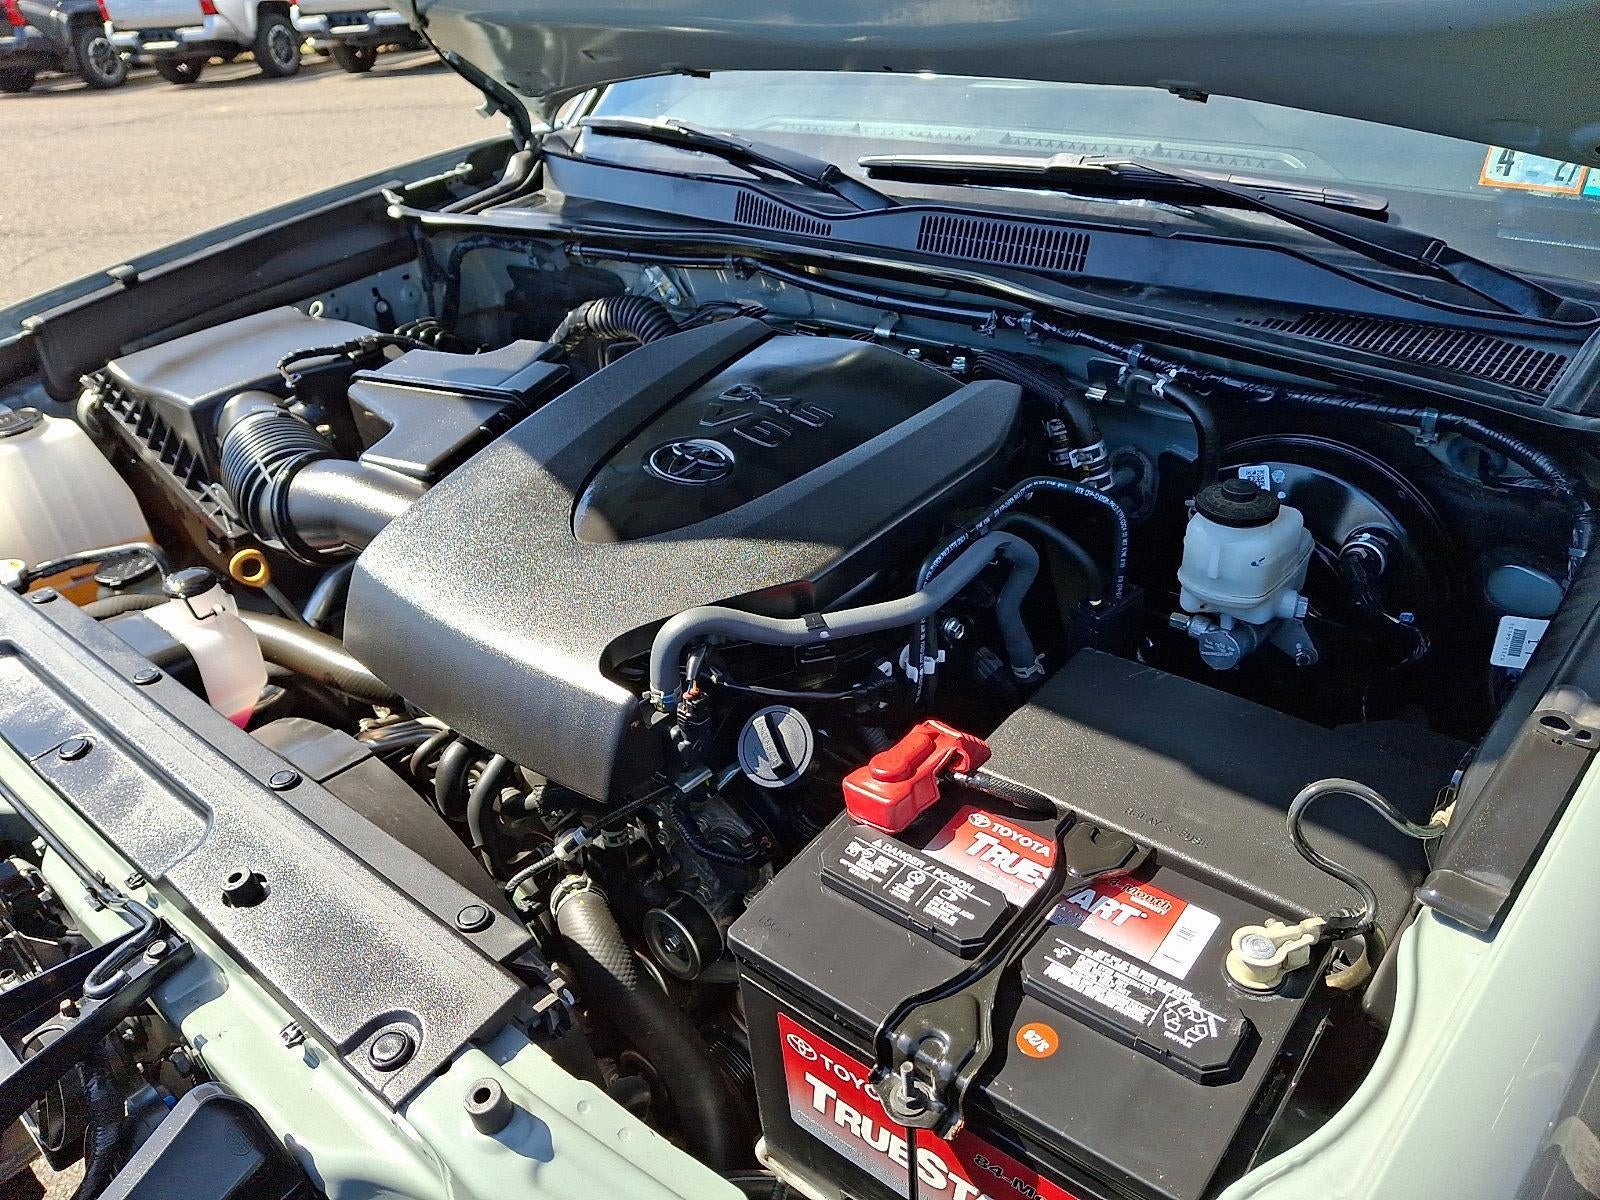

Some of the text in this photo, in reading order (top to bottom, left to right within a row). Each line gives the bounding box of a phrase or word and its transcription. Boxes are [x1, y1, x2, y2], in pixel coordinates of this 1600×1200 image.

[1498, 150, 1515, 176] 4
[991, 822, 1050, 857] TOYOTA
[882, 843, 926, 869] DANGER
[933, 868, 975, 893] POISON
[1109, 878, 1171, 910] 4-Month
[821, 1057, 881, 1102] TOYO
[804, 1072, 997, 1200] TRUEST
